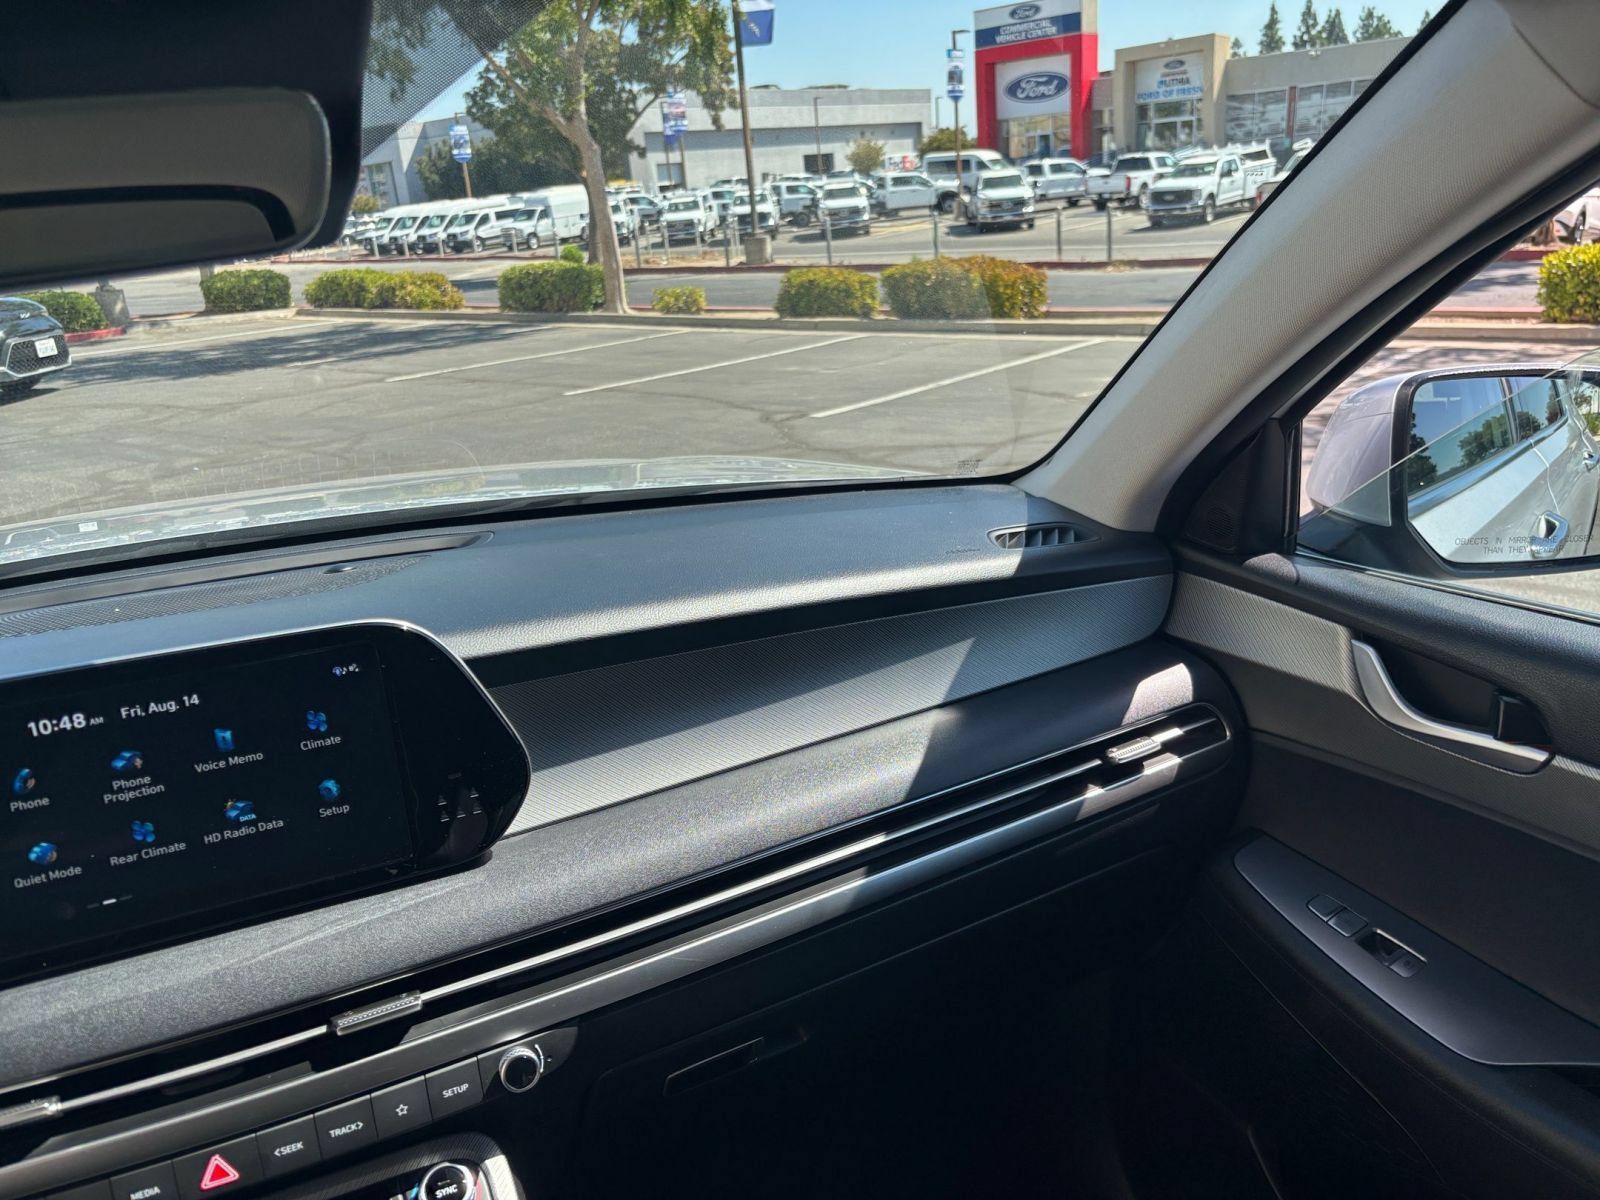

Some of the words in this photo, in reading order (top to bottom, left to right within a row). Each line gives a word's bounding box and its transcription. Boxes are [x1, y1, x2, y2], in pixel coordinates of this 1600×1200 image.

[995, 32, 1026, 44] VEHICLE
[1027, 26, 1057, 39] CENTER
[1016, 75, 1060, 99] Ford
[1455, 537, 1489, 546] OBJECTS
[1495, 537, 1503, 545] IN
[1508, 536, 1537, 544] MIRROR
[1565, 535, 1594, 543] CLOSER
[1484, 546, 1503, 555] THAN
[1508, 546, 1528, 554] THEY
[148, 702, 180, 715] Aug.
[182, 694, 200, 707] 14
[27, 713, 87, 737] 10:48
[89, 717, 104, 726] AM
[300, 735, 342, 750] Climate
[194, 760, 226, 773] Voice
[228, 752, 264, 766] Memo
[112, 775, 151, 791] Phone
[103, 784, 165, 804] Projection
[10, 796, 50, 812] Phone
[319, 804, 350, 818] Setup
[239, 813, 257, 822] DATA
[204, 833, 221, 844] HD
[223, 826, 256, 840] Radio
[258, 819, 284, 832] Data
[109, 853, 138, 866] Rear
[141, 841, 187, 859] Climate
[14, 872, 47, 888] Quiet
[49, 866, 82, 881] Mode
[442, 1083, 469, 1098] SETUP
[129, 1186, 161, 1200] MEDIA
[435, 1184, 458, 1199] SYNC
